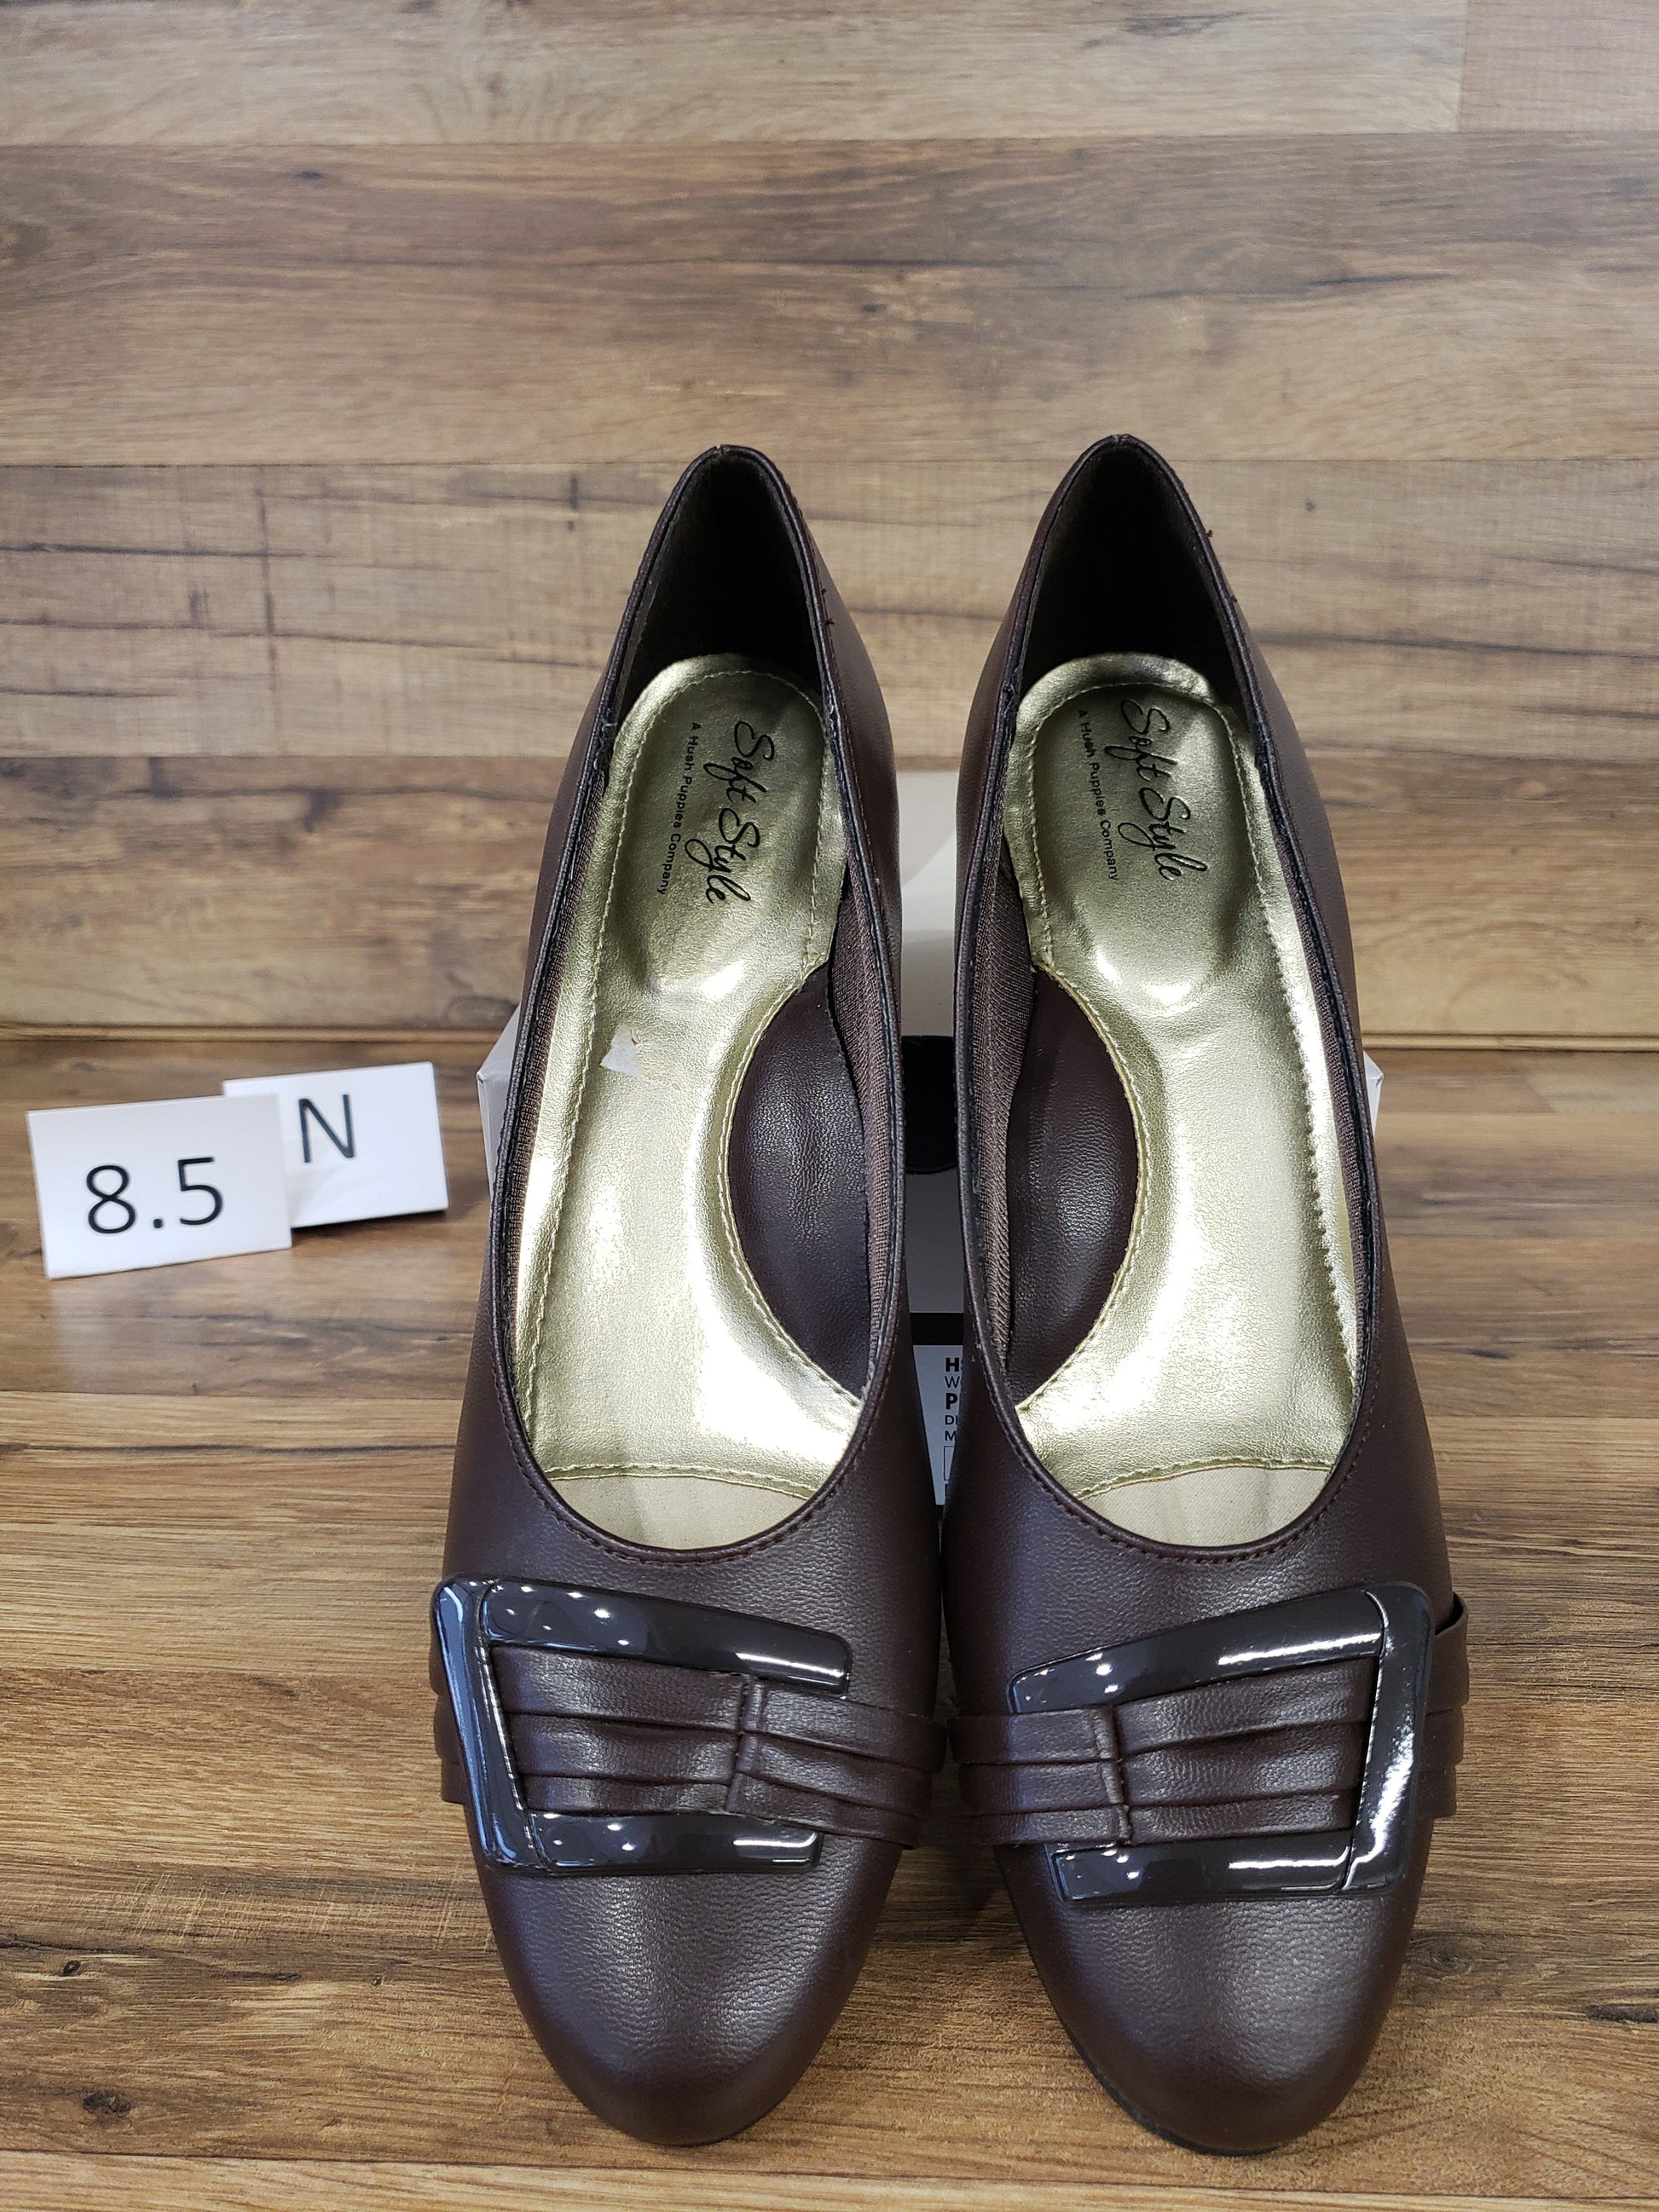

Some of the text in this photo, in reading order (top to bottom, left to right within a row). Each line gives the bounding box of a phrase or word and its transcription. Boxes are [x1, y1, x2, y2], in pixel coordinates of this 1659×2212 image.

[656, 722, 702, 895] A Hush Puppies Company
[685, 721, 775, 904] Soft Style
[1078, 710, 1119, 881] A Hush Puppies Company
[1104, 699, 1207, 881] Soft Style
[85, 1156, 223, 1234] 8.5
[298, 1094, 355, 1164] N
[945, 1357, 963, 1372] H
